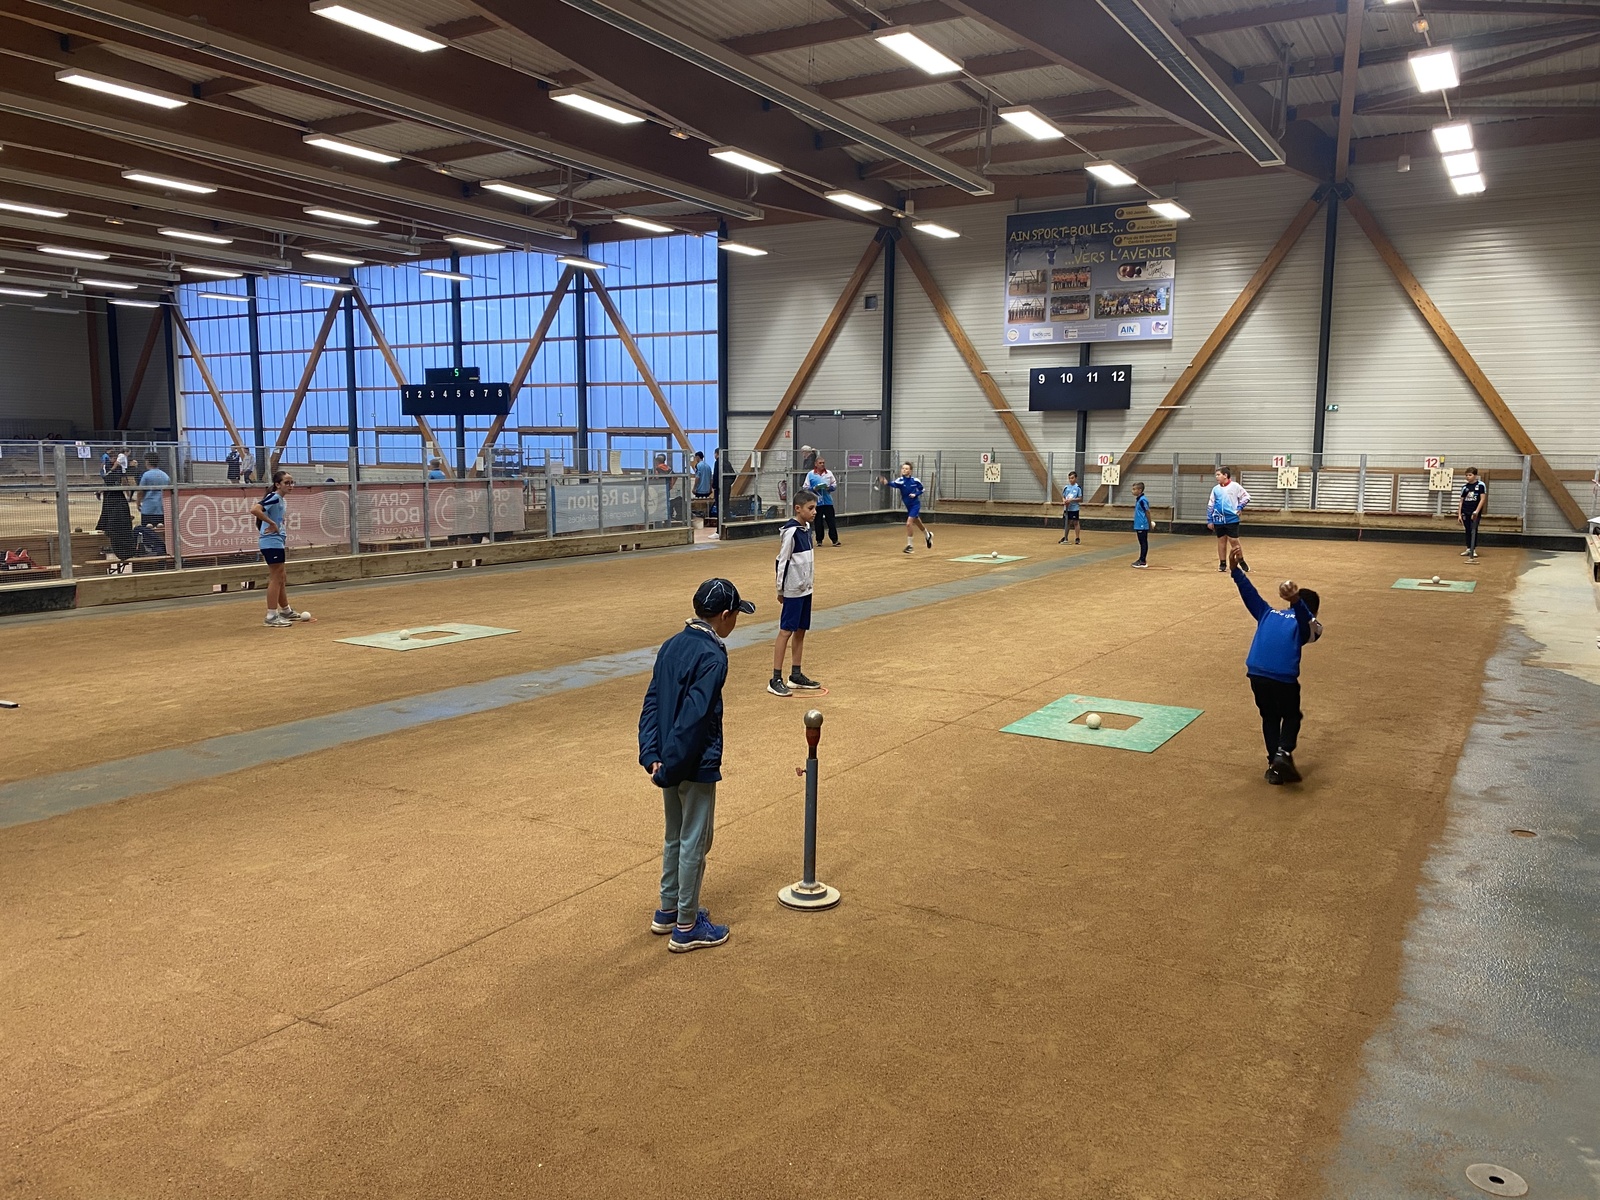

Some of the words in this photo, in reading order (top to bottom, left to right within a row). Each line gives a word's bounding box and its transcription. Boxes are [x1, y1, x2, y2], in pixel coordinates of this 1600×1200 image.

[1010, 231, 1030, 242] AIN
[1110, 246, 1172, 262] L'AVENIR
[1120, 325, 1134, 334] AIN
[1038, 373, 1046, 384] 9
[1060, 372, 1073, 384] 10
[1086, 371, 1098, 383] 11
[1111, 370, 1125, 382] 12
[405, 390, 409, 398] 1
[417, 390, 422, 398] 2
[430, 390, 435, 398] 3
[443, 390, 448, 398] 4
[456, 389, 461, 398] 5
[469, 389, 475, 397] 6
[483, 389, 488, 397] 7
[497, 389, 503, 397] 8
[982, 454, 989, 463] 9
[1099, 455, 1109, 465] 10
[1273, 456, 1284, 467] 11
[1425, 457, 1438, 469] 12
